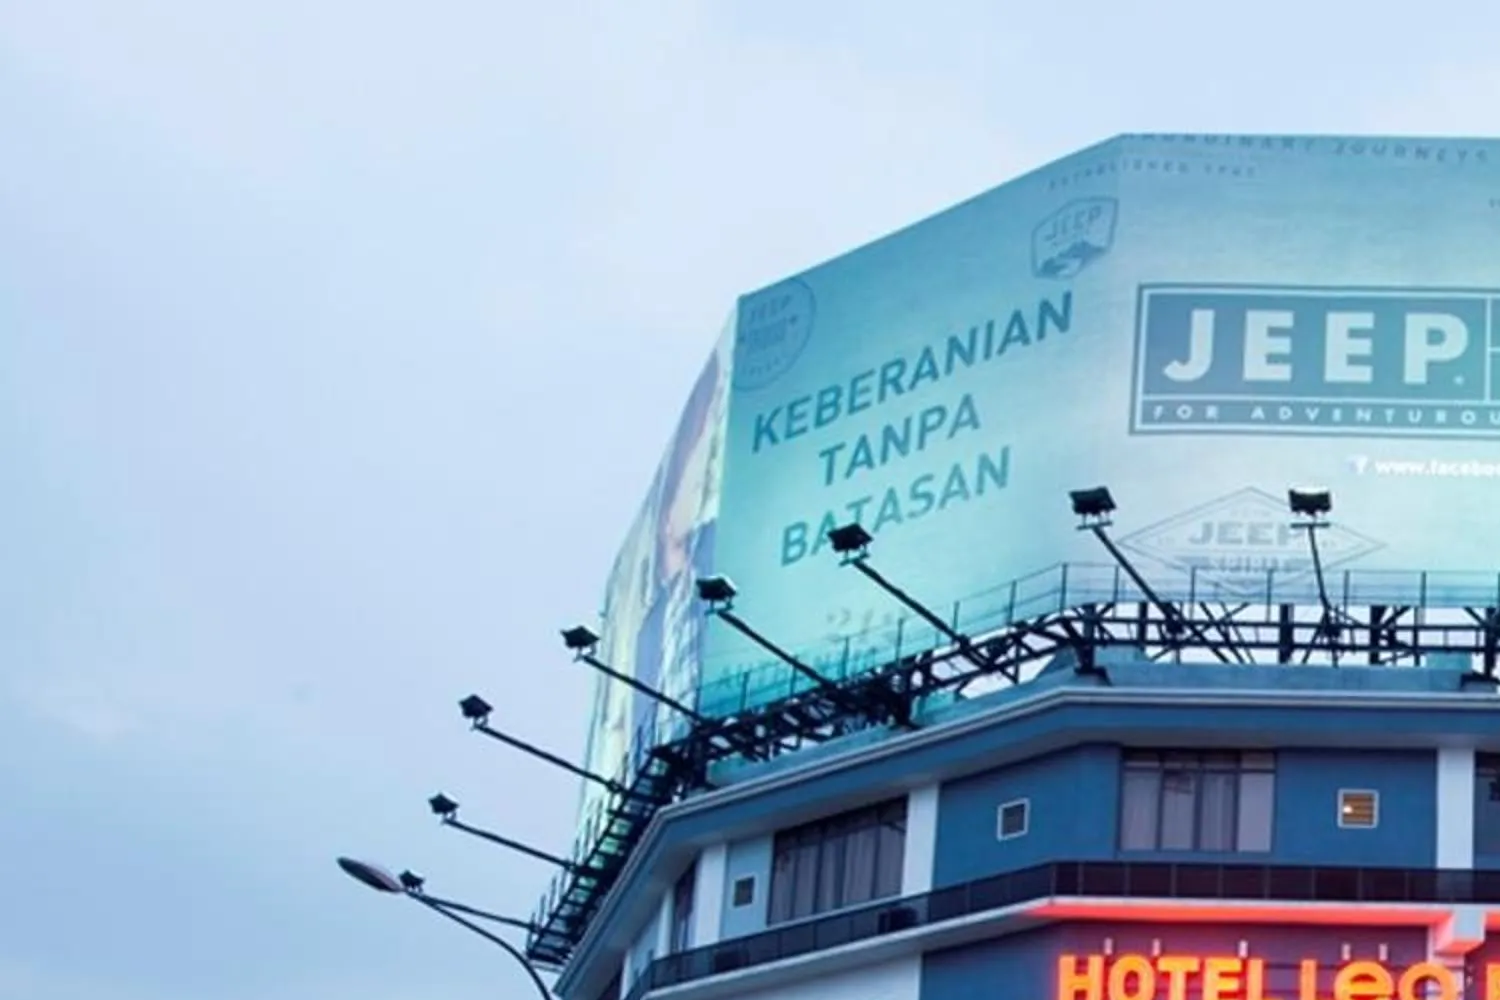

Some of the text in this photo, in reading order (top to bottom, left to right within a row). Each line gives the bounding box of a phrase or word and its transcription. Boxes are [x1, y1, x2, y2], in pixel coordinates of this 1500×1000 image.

[752, 290, 1072, 453] KEBERANIAN
[1162, 309, 1471, 385] JEEP
[818, 393, 981, 486] TANPA
[1153, 404, 1219, 421] FOR
[780, 446, 1011, 567] BATASAN
